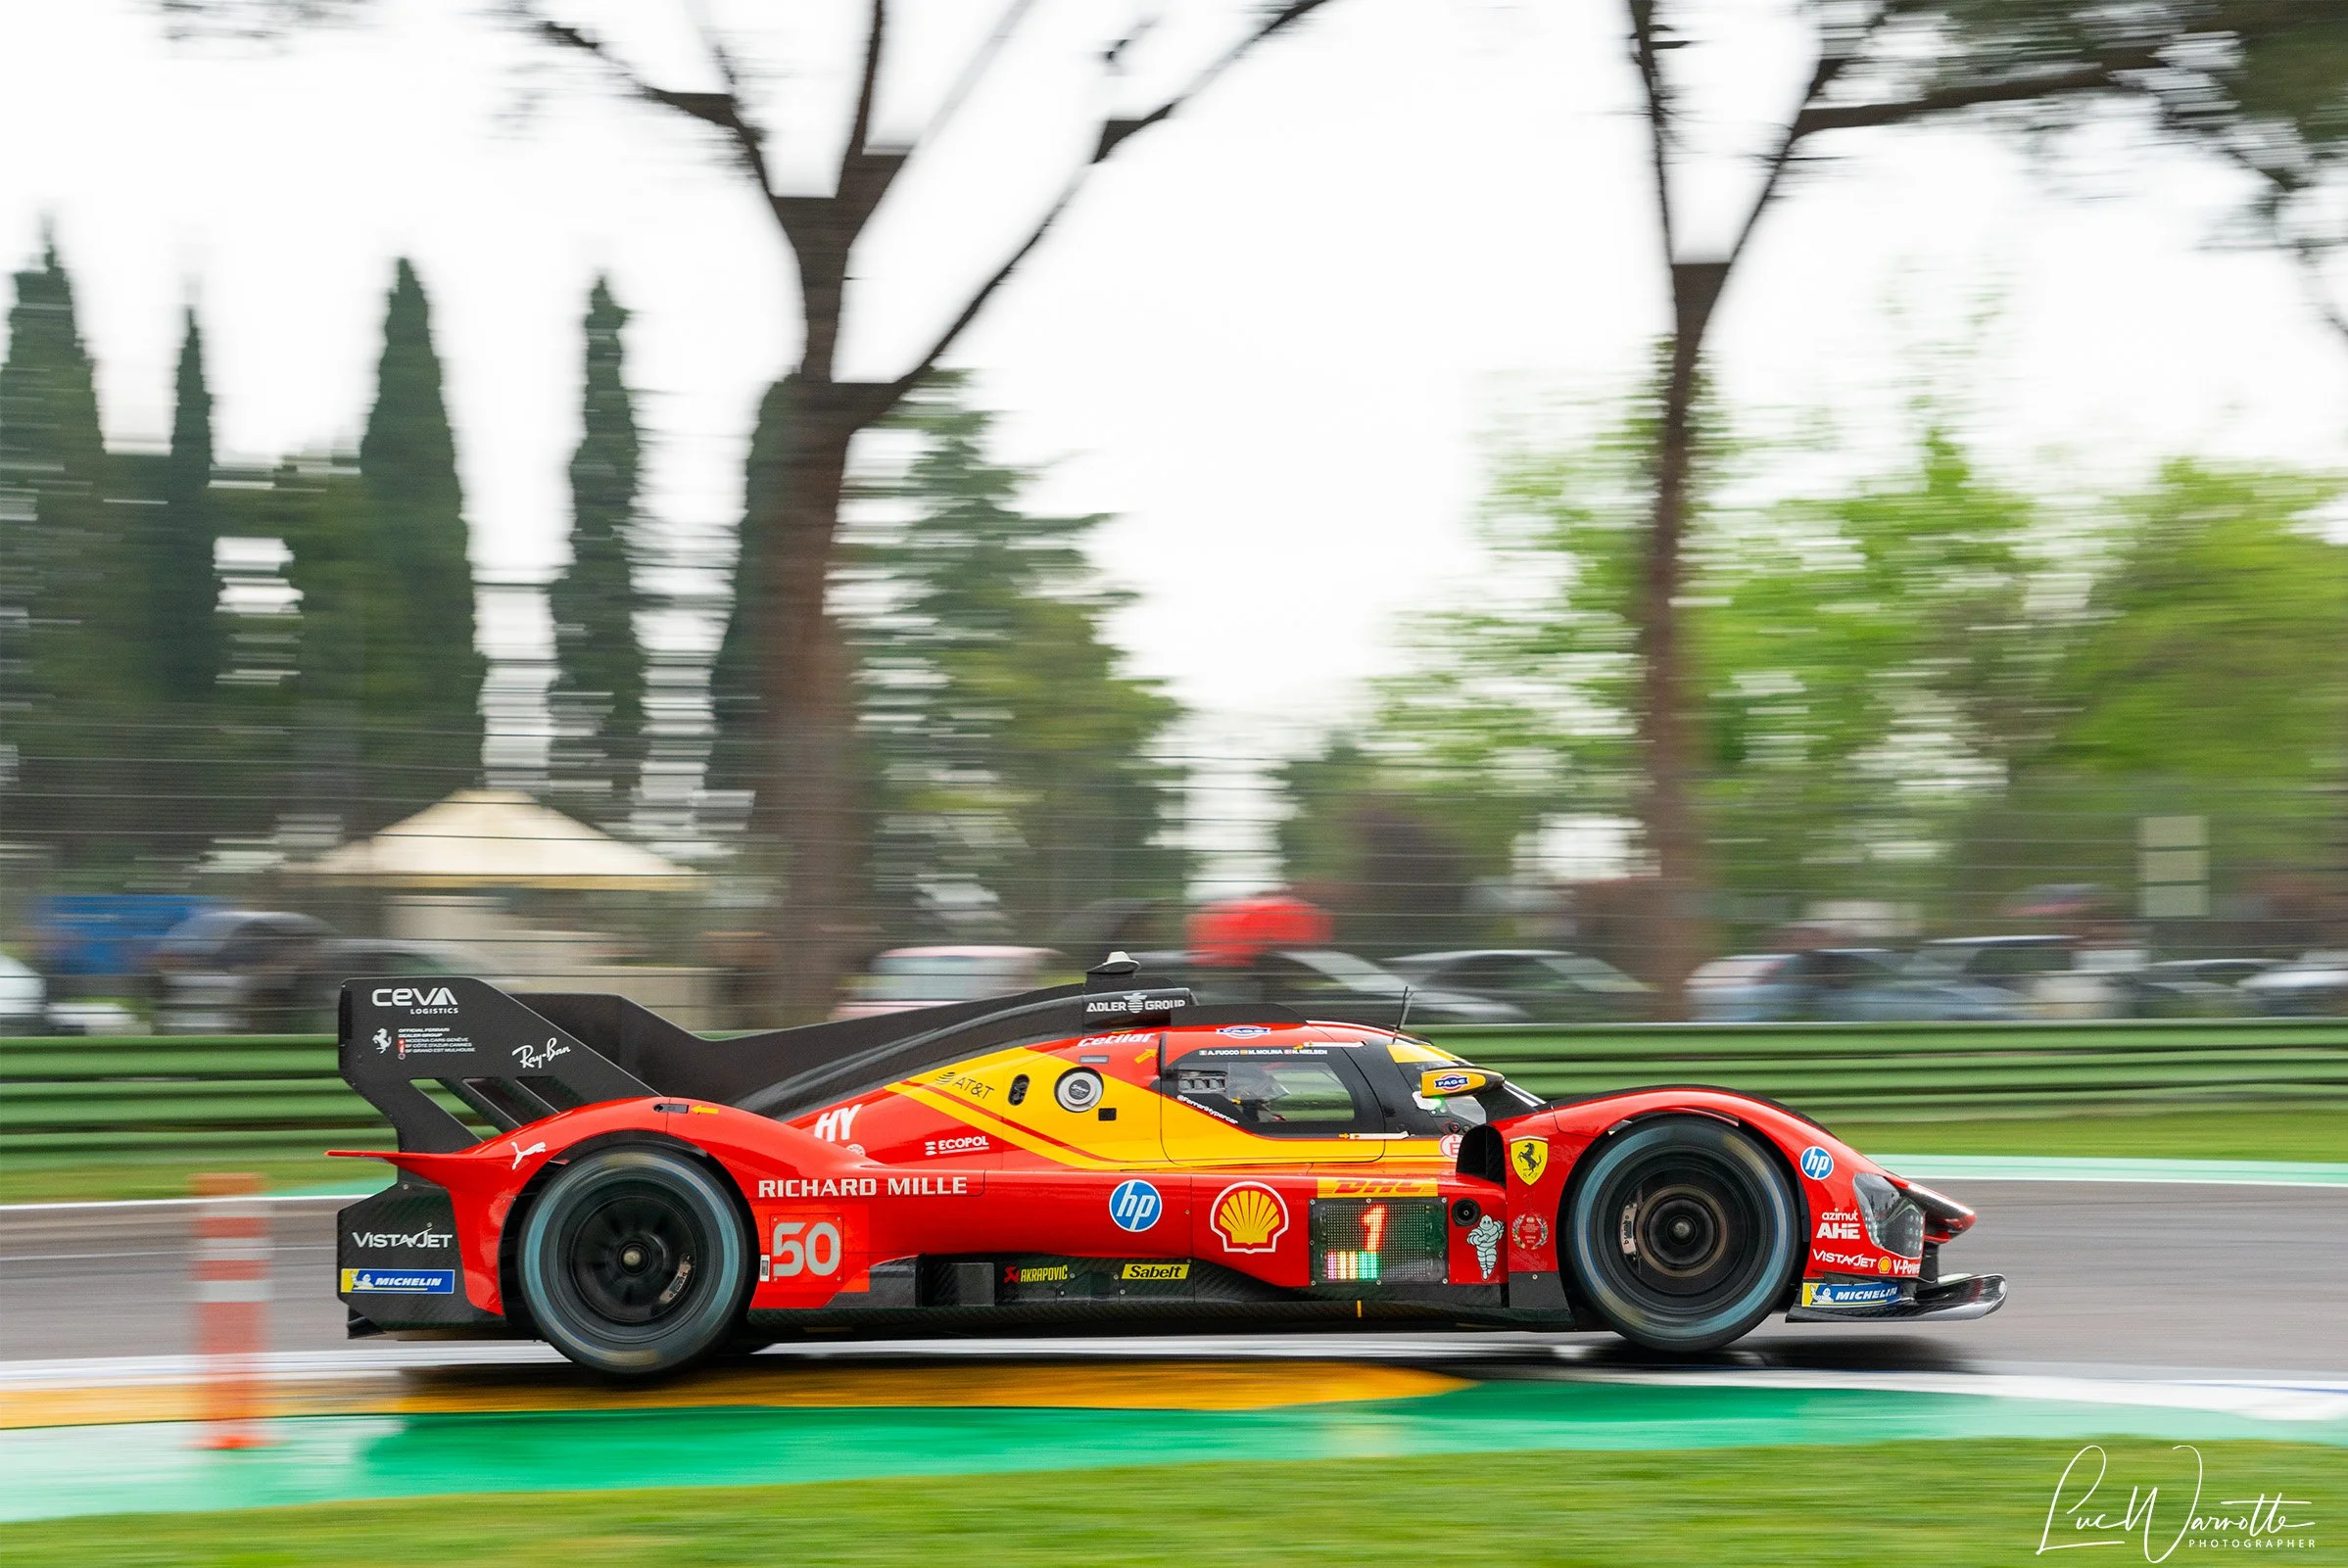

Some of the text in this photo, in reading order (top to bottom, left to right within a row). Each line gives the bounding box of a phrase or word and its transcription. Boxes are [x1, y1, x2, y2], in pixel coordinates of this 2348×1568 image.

[1086, 1000, 1186, 1012] ADLER GROUP
[511, 1037, 571, 1069] Ray-Ban
[952, 1077, 994, 1099] AT&T
[814, 1104, 863, 1143] HY
[938, 1136, 989, 1150] ECOPOL
[1804, 1147, 1830, 1179] hp
[758, 1176, 968, 1198] RICHARD MILLE
[1334, 1180, 1422, 1194] DHL
[1116, 1180, 1157, 1231] hp
[1822, 1208, 1858, 1221] azimut
[1363, 1206, 1386, 1252] 1
[1816, 1222, 1860, 1240] AHE
[773, 1221, 840, 1276] 50
[374, 1277, 442, 1286] MICHELIN
[1129, 1265, 1182, 1278] Sabelt
[1836, 1286, 1898, 1301] MICHELIN
